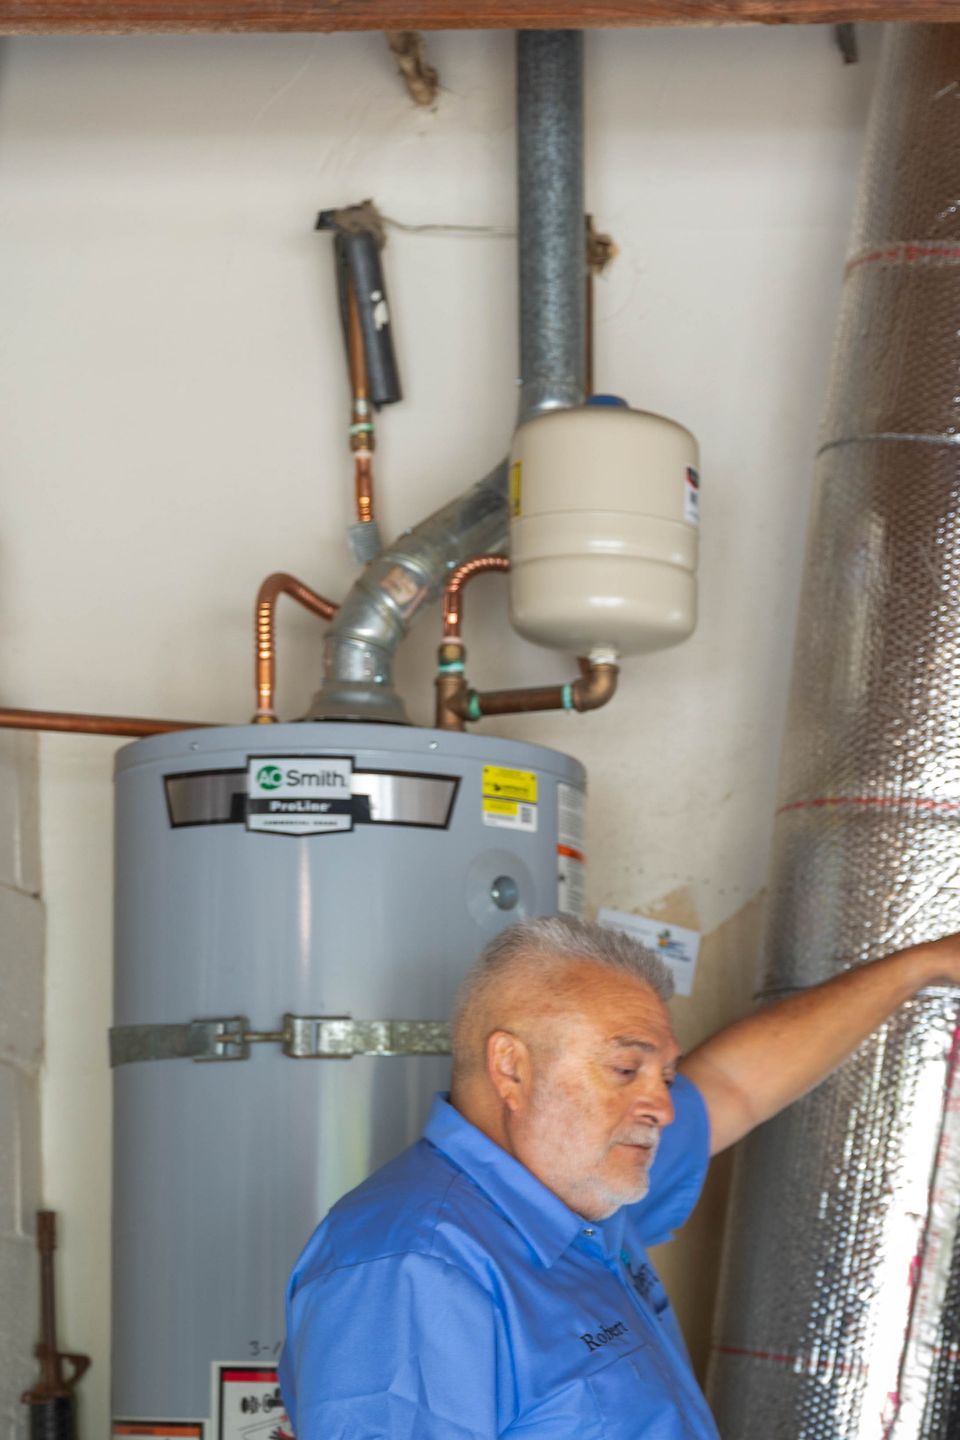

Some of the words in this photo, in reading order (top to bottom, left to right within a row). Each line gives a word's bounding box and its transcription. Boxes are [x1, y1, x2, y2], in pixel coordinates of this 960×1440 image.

[286, 769, 346, 787] Smith
[269, 800, 330, 812] ProLine
[579, 1320, 629, 1352] Robert
